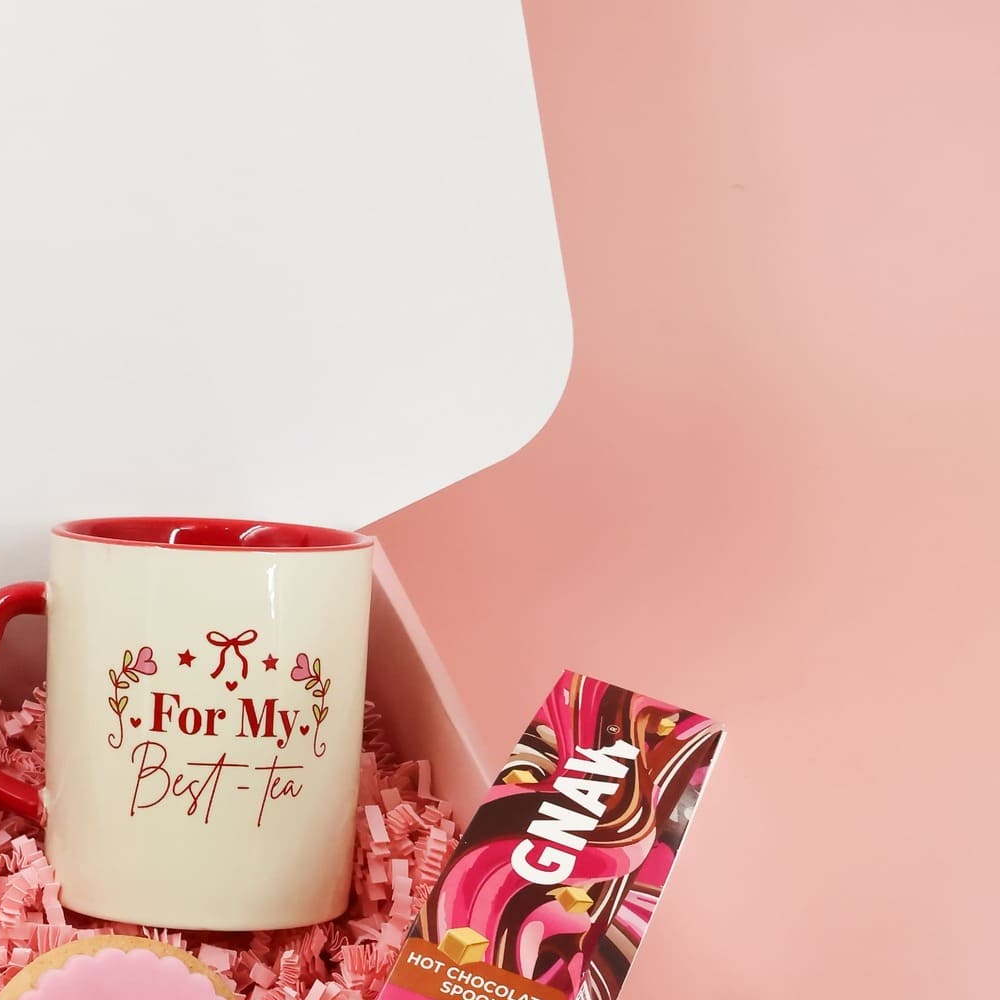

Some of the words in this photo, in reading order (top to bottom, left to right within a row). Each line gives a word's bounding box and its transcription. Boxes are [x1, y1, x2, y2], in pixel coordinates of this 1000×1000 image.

[149, 691, 226, 736] For
[235, 697, 300, 749] My
[407, 952, 445, 973] HOT
